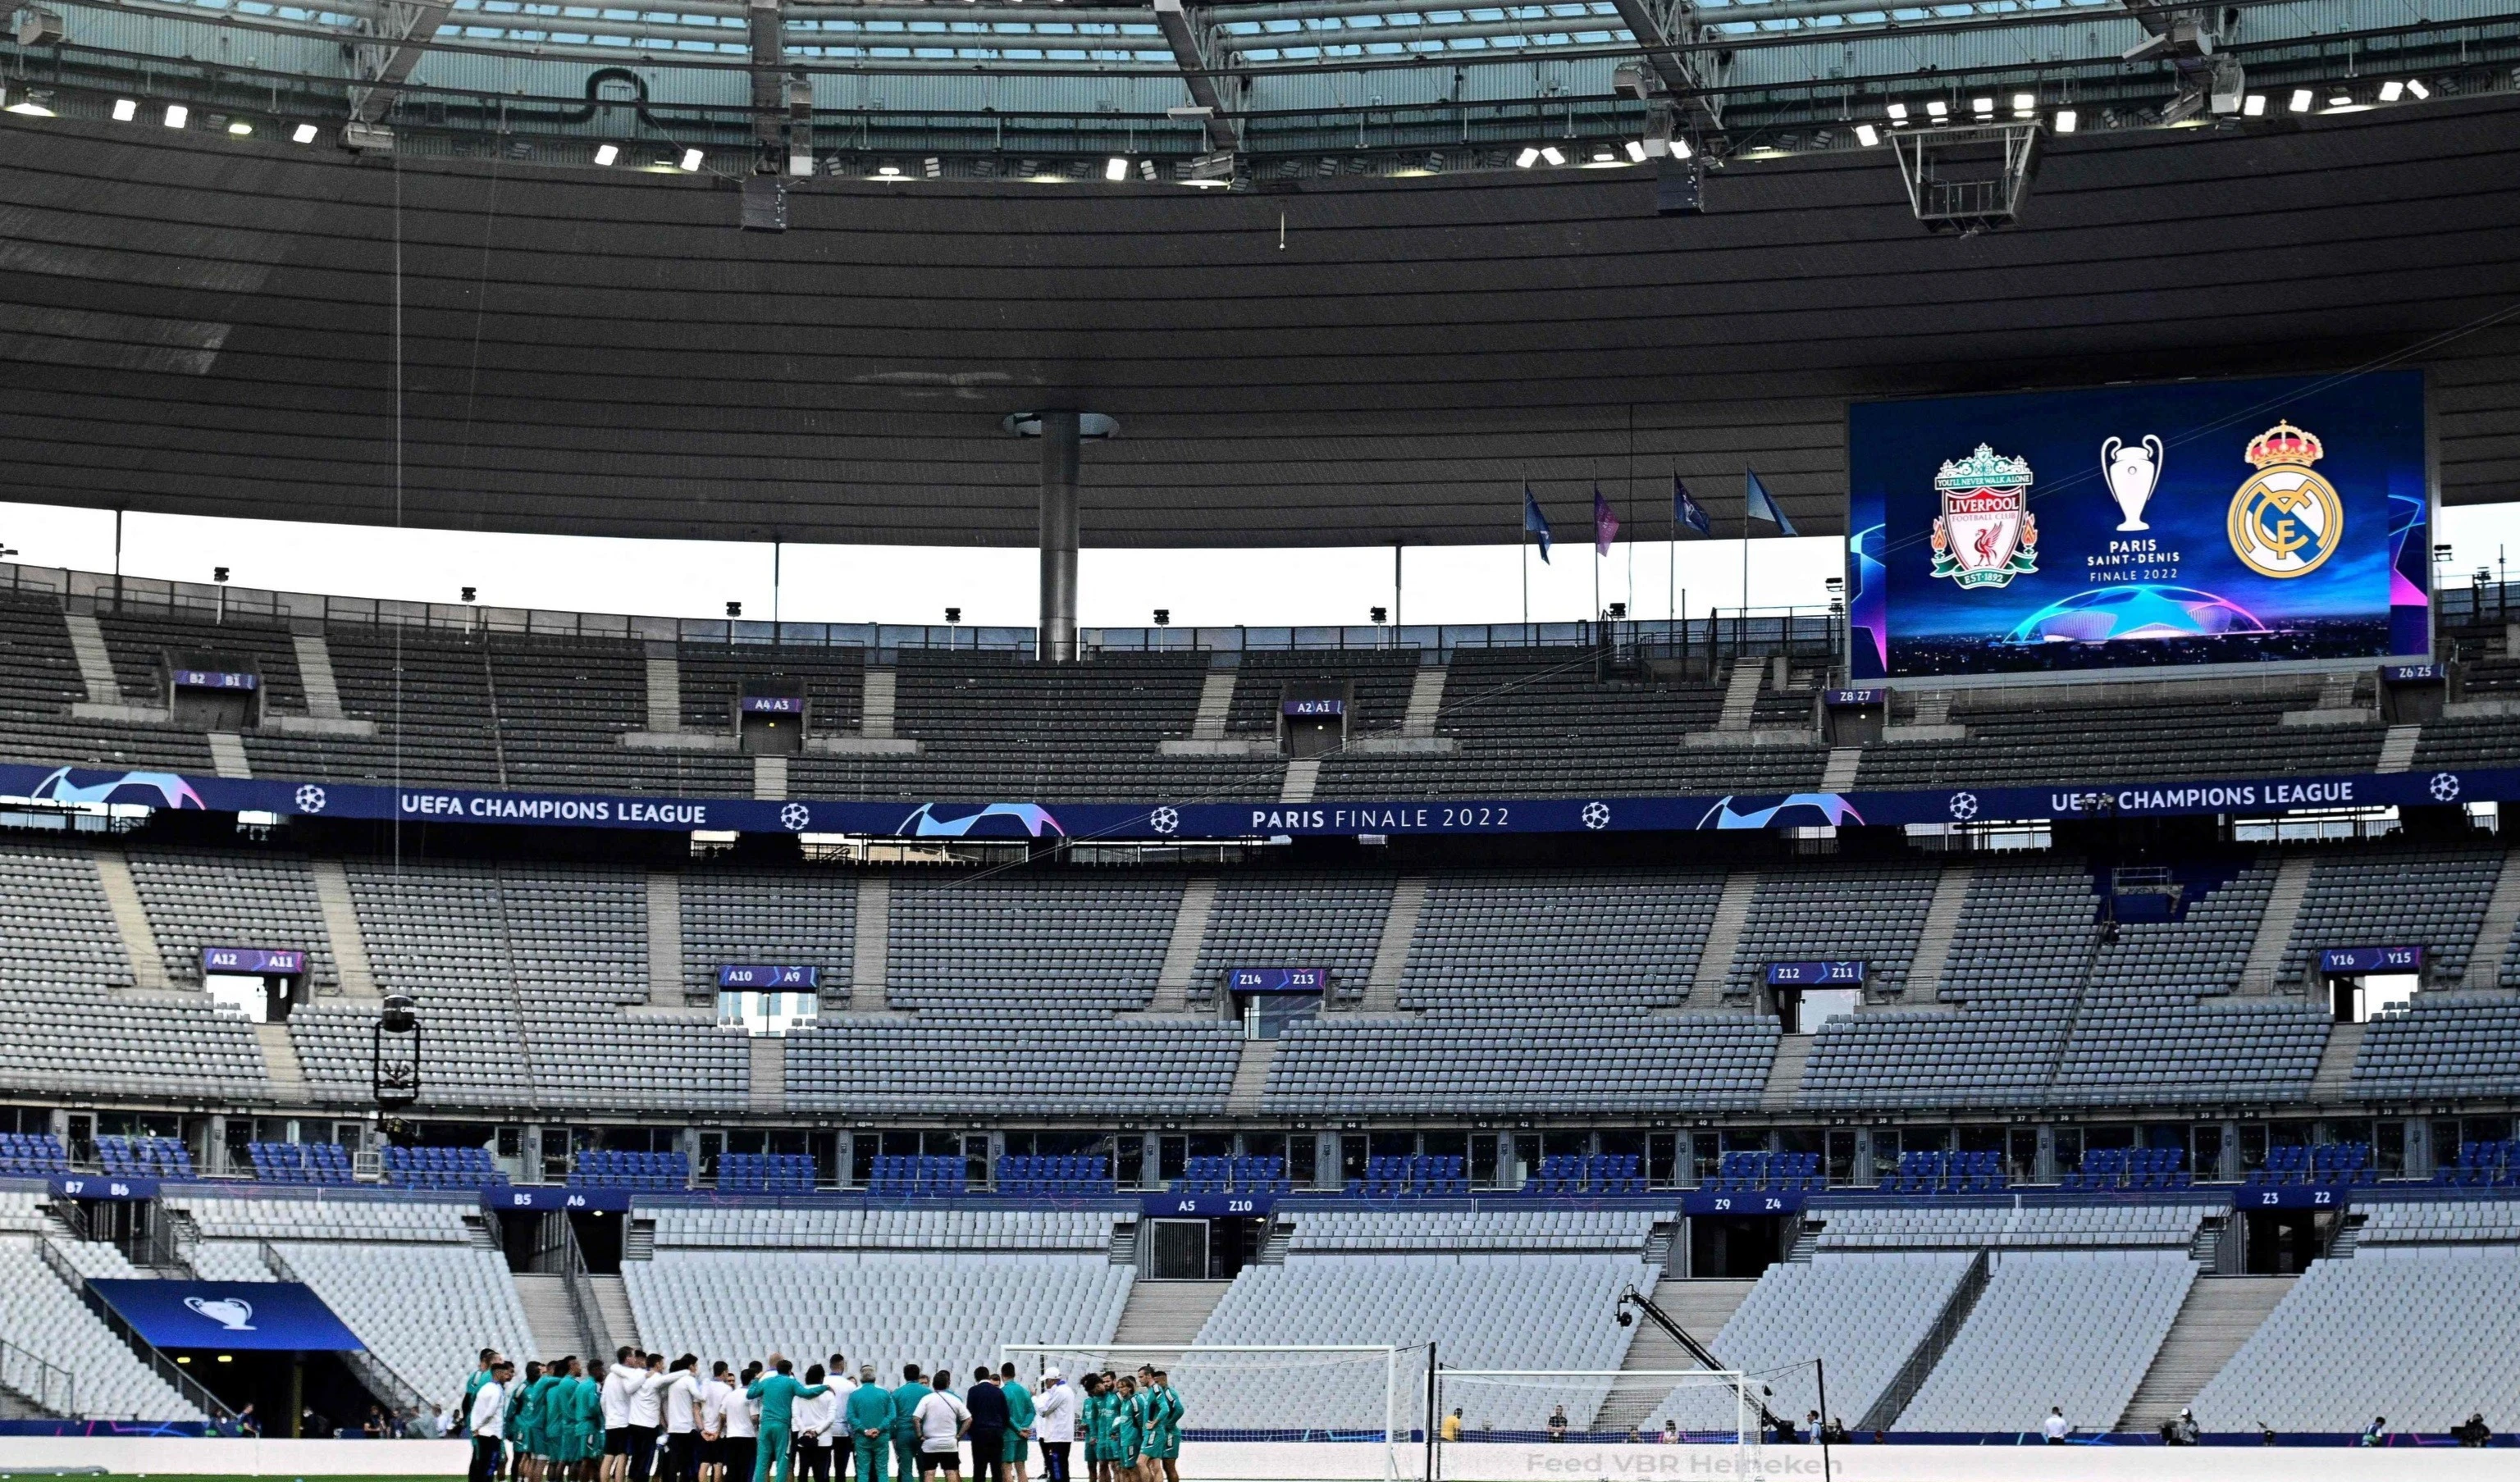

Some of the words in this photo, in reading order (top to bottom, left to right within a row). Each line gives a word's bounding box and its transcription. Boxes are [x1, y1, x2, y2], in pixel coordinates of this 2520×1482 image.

[1961, 477, 1984, 486] NEVER
[1984, 476, 2006, 484] WALK
[2005, 475, 2029, 483] ALONE
[1949, 497, 2020, 513] LIVERPOOL
[1952, 514, 1993, 522] FOOTBALL
[1995, 513, 2016, 521] CLUB
[2110, 539, 2157, 553] PARIS
[2087, 552, 2180, 566] SAINT-DENIS
[2090, 571, 2137, 581] FINALE
[2143, 568, 2177, 580] 2022
[2399, 668, 2413, 677] Z6
[2417, 667, 2431, 677] Z5
[189, 673, 205, 684] B2
[225, 675, 240, 686] B1
[1840, 692, 1853, 701] Z8
[1857, 691, 1871, 700] Z7
[756, 700, 770, 709] A4
[774, 700, 788, 710] A3
[1297, 703, 1312, 712] A2
[1316, 703, 1330, 713] A1
[2118, 787, 2255, 809] CHAMPIONS
[2264, 782, 2353, 805] LEAGUE
[402, 795, 463, 815] UEFA
[470, 798, 609, 820] CHAMPIONS
[618, 804, 706, 823] LEAGUE
[1253, 811, 1324, 828] PARIS
[1335, 809, 1427, 828] FINALE
[1442, 808, 1509, 827] 2022
[212, 953, 237, 965] A12
[269, 955, 294, 968] A11
[2331, 955, 2354, 965] Y16
[2388, 952, 2411, 964] Y15
[728, 971, 752, 982] A10
[783, 971, 801, 982] A9
[1239, 974, 1262, 984] Z14
[1293, 974, 1314, 984] Z13
[1778, 969, 1800, 978] Z12
[1832, 968, 1853, 978] Z11
[66, 1181, 84, 1193] B7
[111, 1183, 130, 1196] B6
[514, 1193, 532, 1206] B5
[567, 1195, 586, 1206] A6
[1714, 1199, 1731, 1210] Z9
[1765, 1198, 1782, 1209] Z4
[2262, 1192, 2279, 1204] Z3
[2314, 1192, 2331, 1203] Z2
[1178, 1201, 1195, 1211] A5
[1229, 1201, 1253, 1211] Z10
[1527, 1453, 1602, 1474] Feed
[1613, 1453, 1680, 1474] VBR
